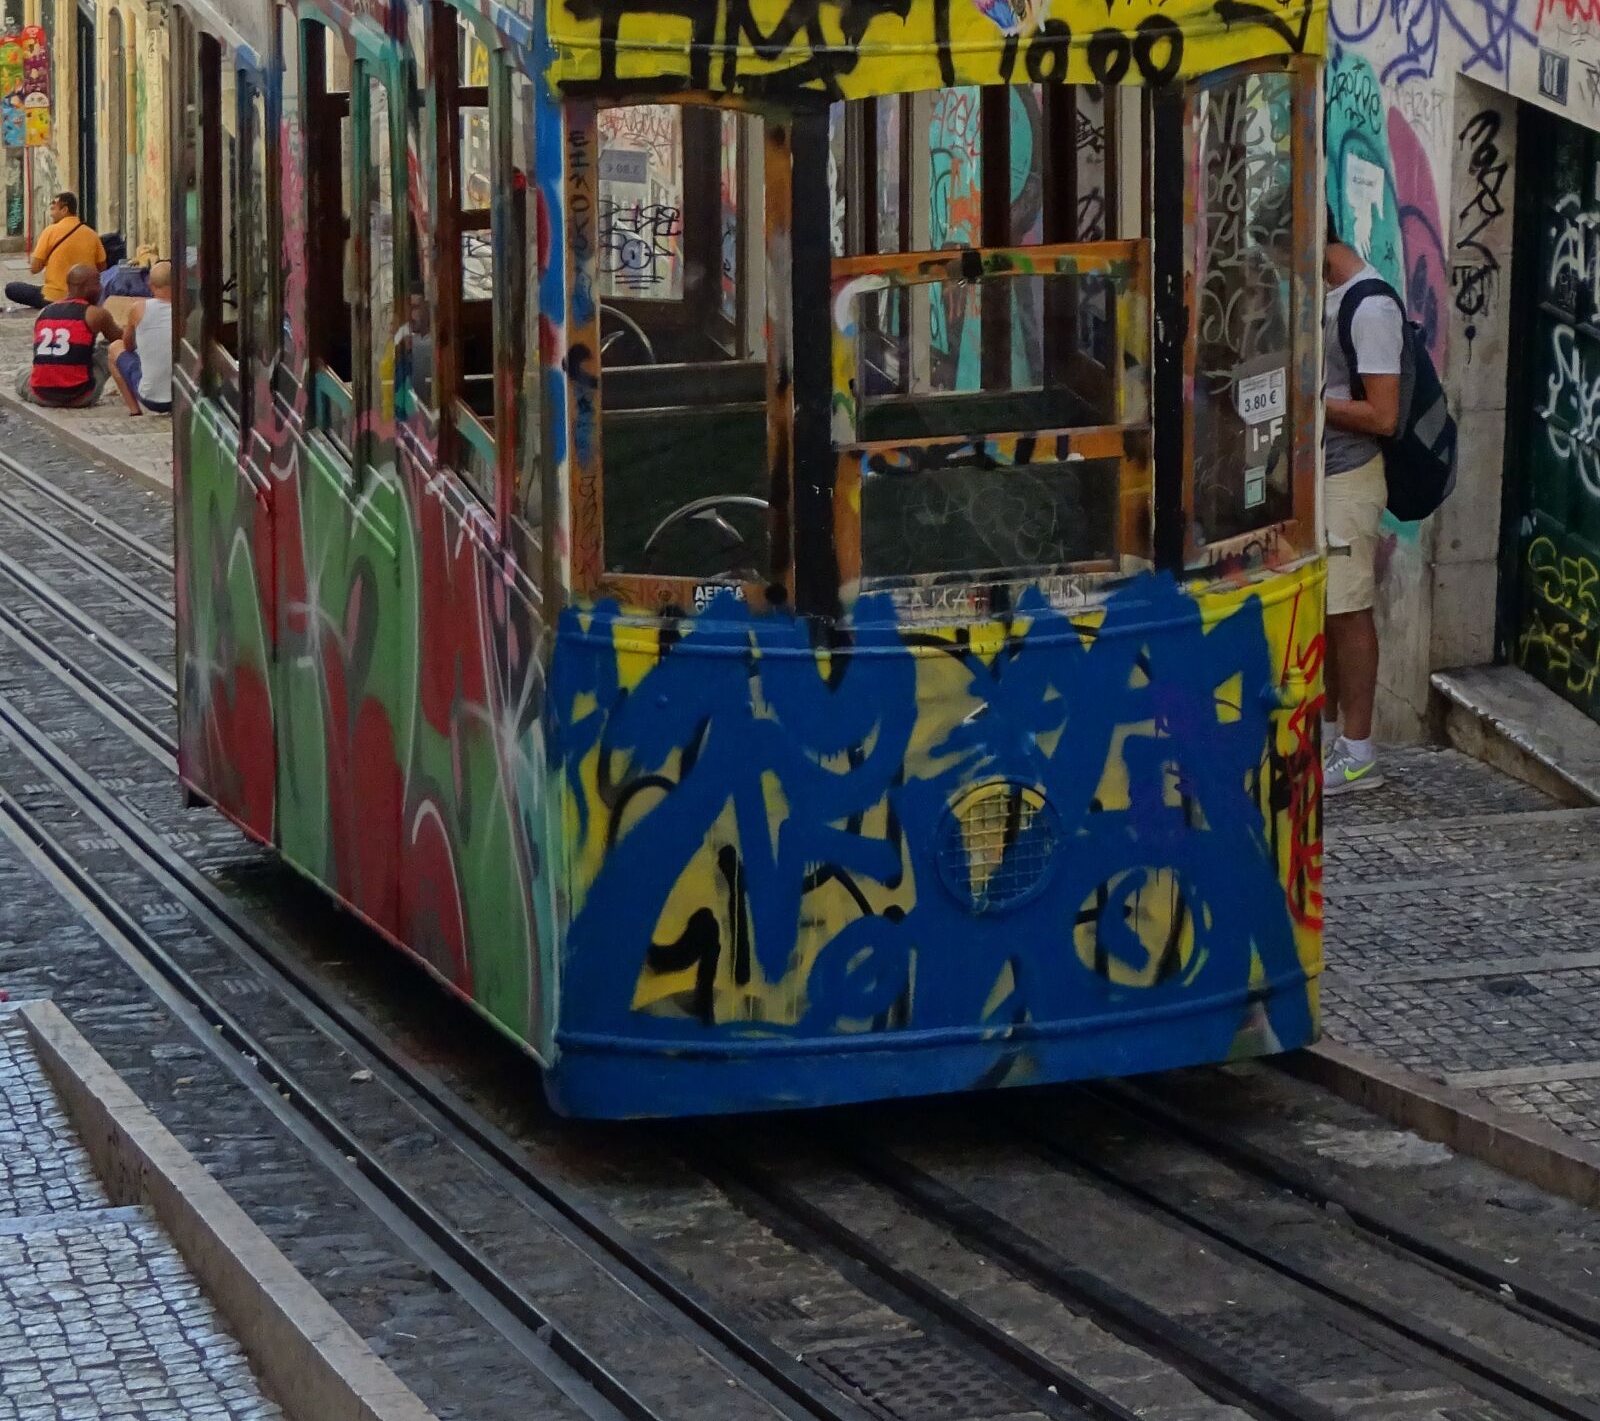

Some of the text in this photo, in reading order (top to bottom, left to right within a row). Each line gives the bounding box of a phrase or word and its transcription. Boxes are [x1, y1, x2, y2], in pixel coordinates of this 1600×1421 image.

[37, 327, 71, 356] 23
[1244, 393, 1267, 413] 3.80
[1269, 389, 1277, 404] €
